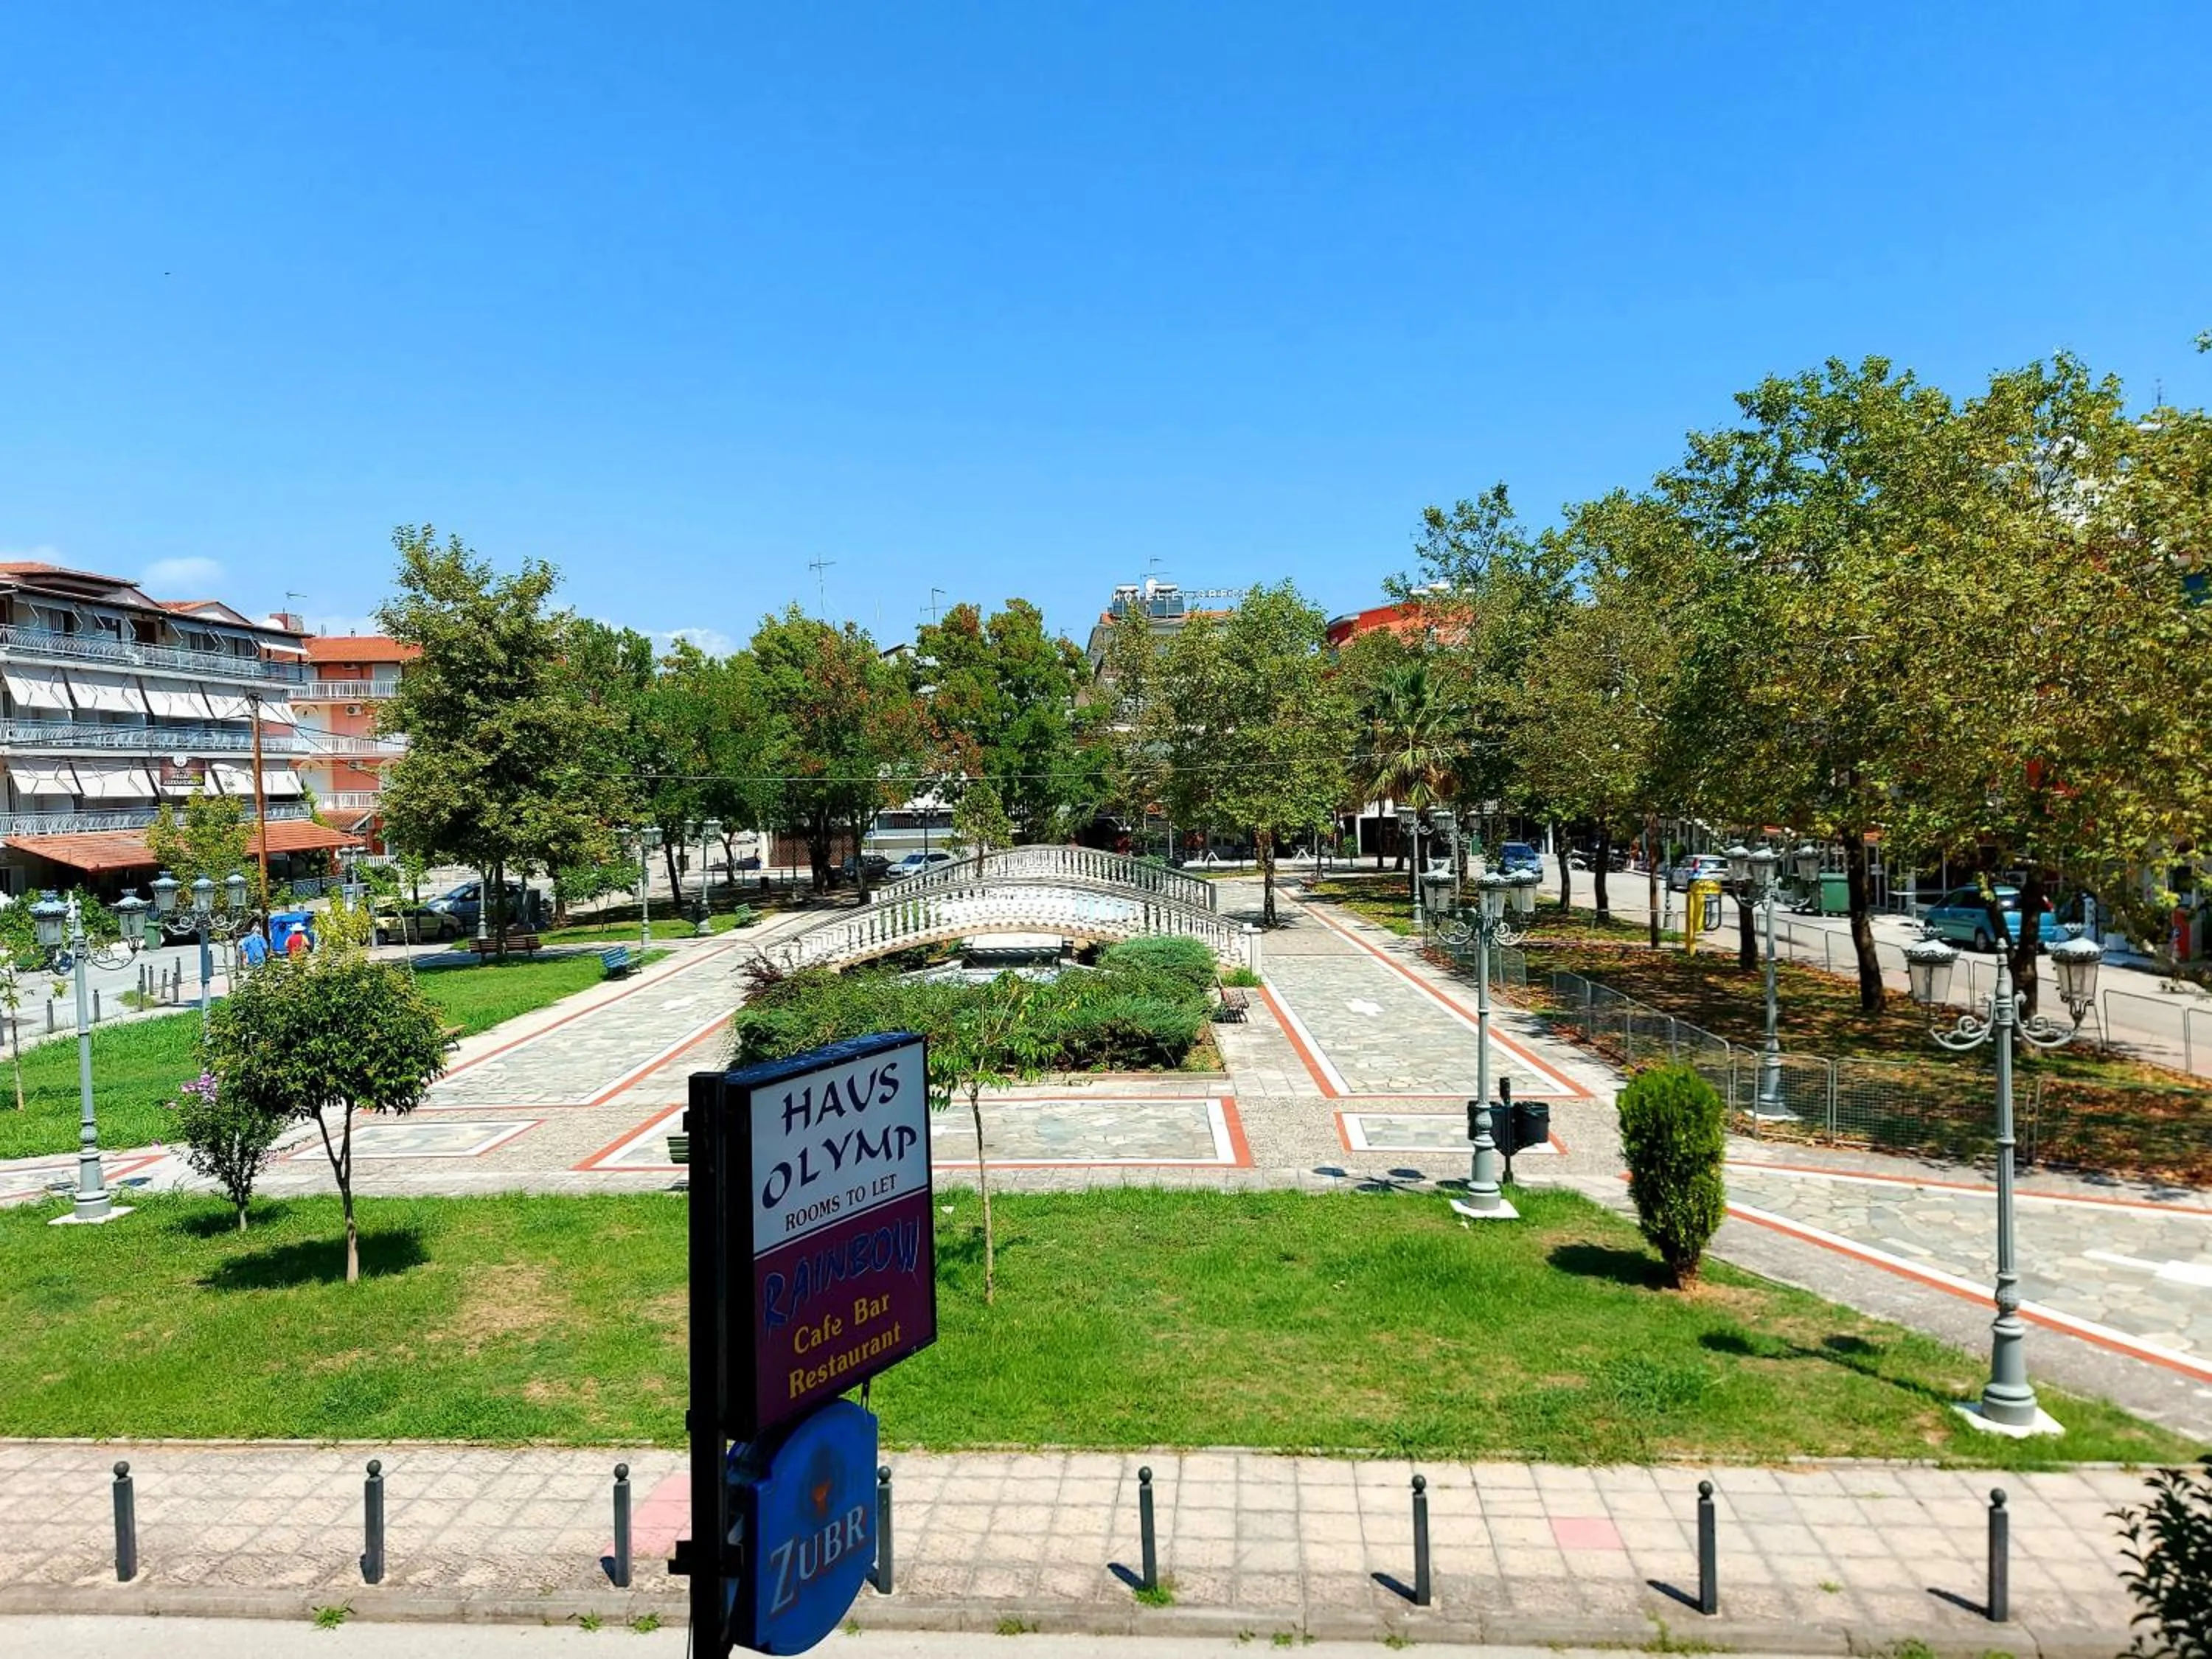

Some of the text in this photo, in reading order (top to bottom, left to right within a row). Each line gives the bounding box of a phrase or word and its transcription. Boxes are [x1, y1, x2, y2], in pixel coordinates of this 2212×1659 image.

[782, 1062, 899, 1136] HAUS
[762, 1124, 917, 1208] OLYMP
[785, 1174, 897, 1232] ROOMS TO LET
[763, 1216, 919, 1330] RAINBOW
[788, 1321, 901, 1399] Restaurant
[794, 1293, 890, 1354] Cafe Bar
[770, 1505, 869, 1617] ZUBR
